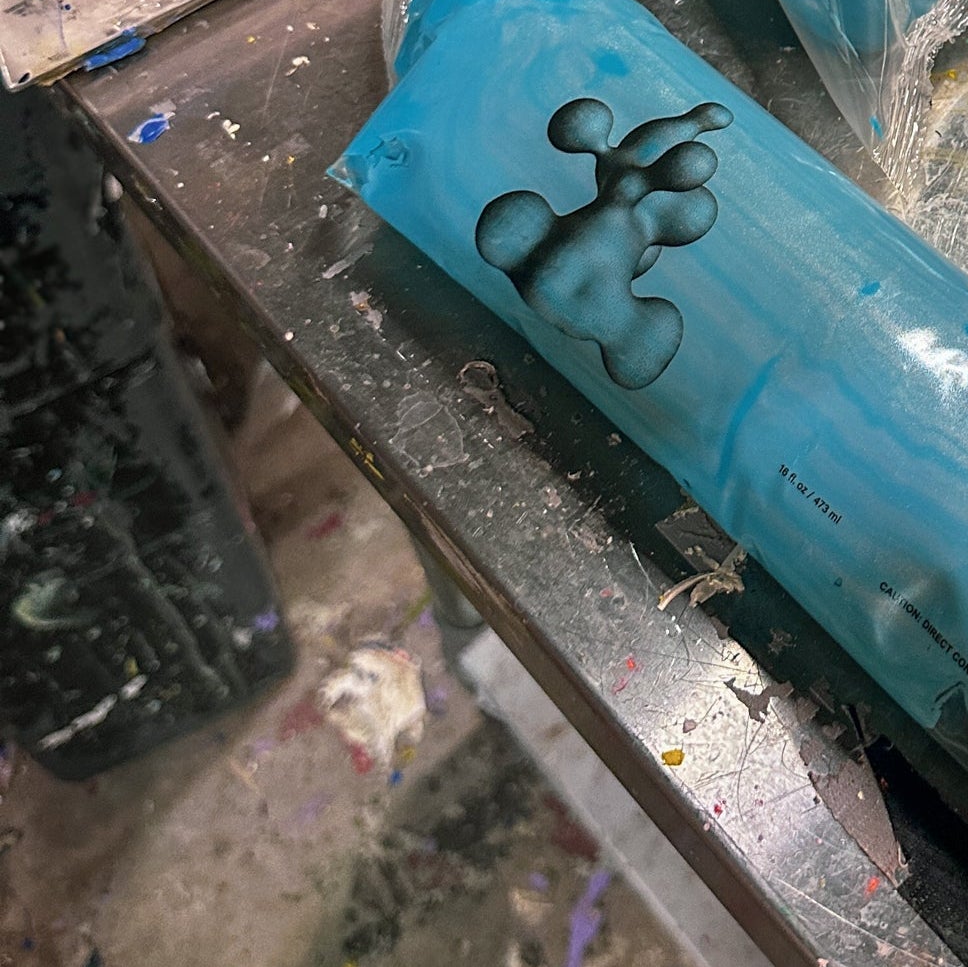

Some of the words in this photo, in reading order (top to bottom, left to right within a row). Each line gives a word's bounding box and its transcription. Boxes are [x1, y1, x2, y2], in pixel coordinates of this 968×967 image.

[778, 464, 790, 477] 16
[788, 472, 798, 485] fl.
[797, 482, 808, 494] oz
[806, 491, 815, 499] /
[813, 496, 830, 514] 473
[828, 510, 843, 525] ml
[879, 581, 923, 624] CAUTION:
[921, 619, 954, 655] DIRECT
